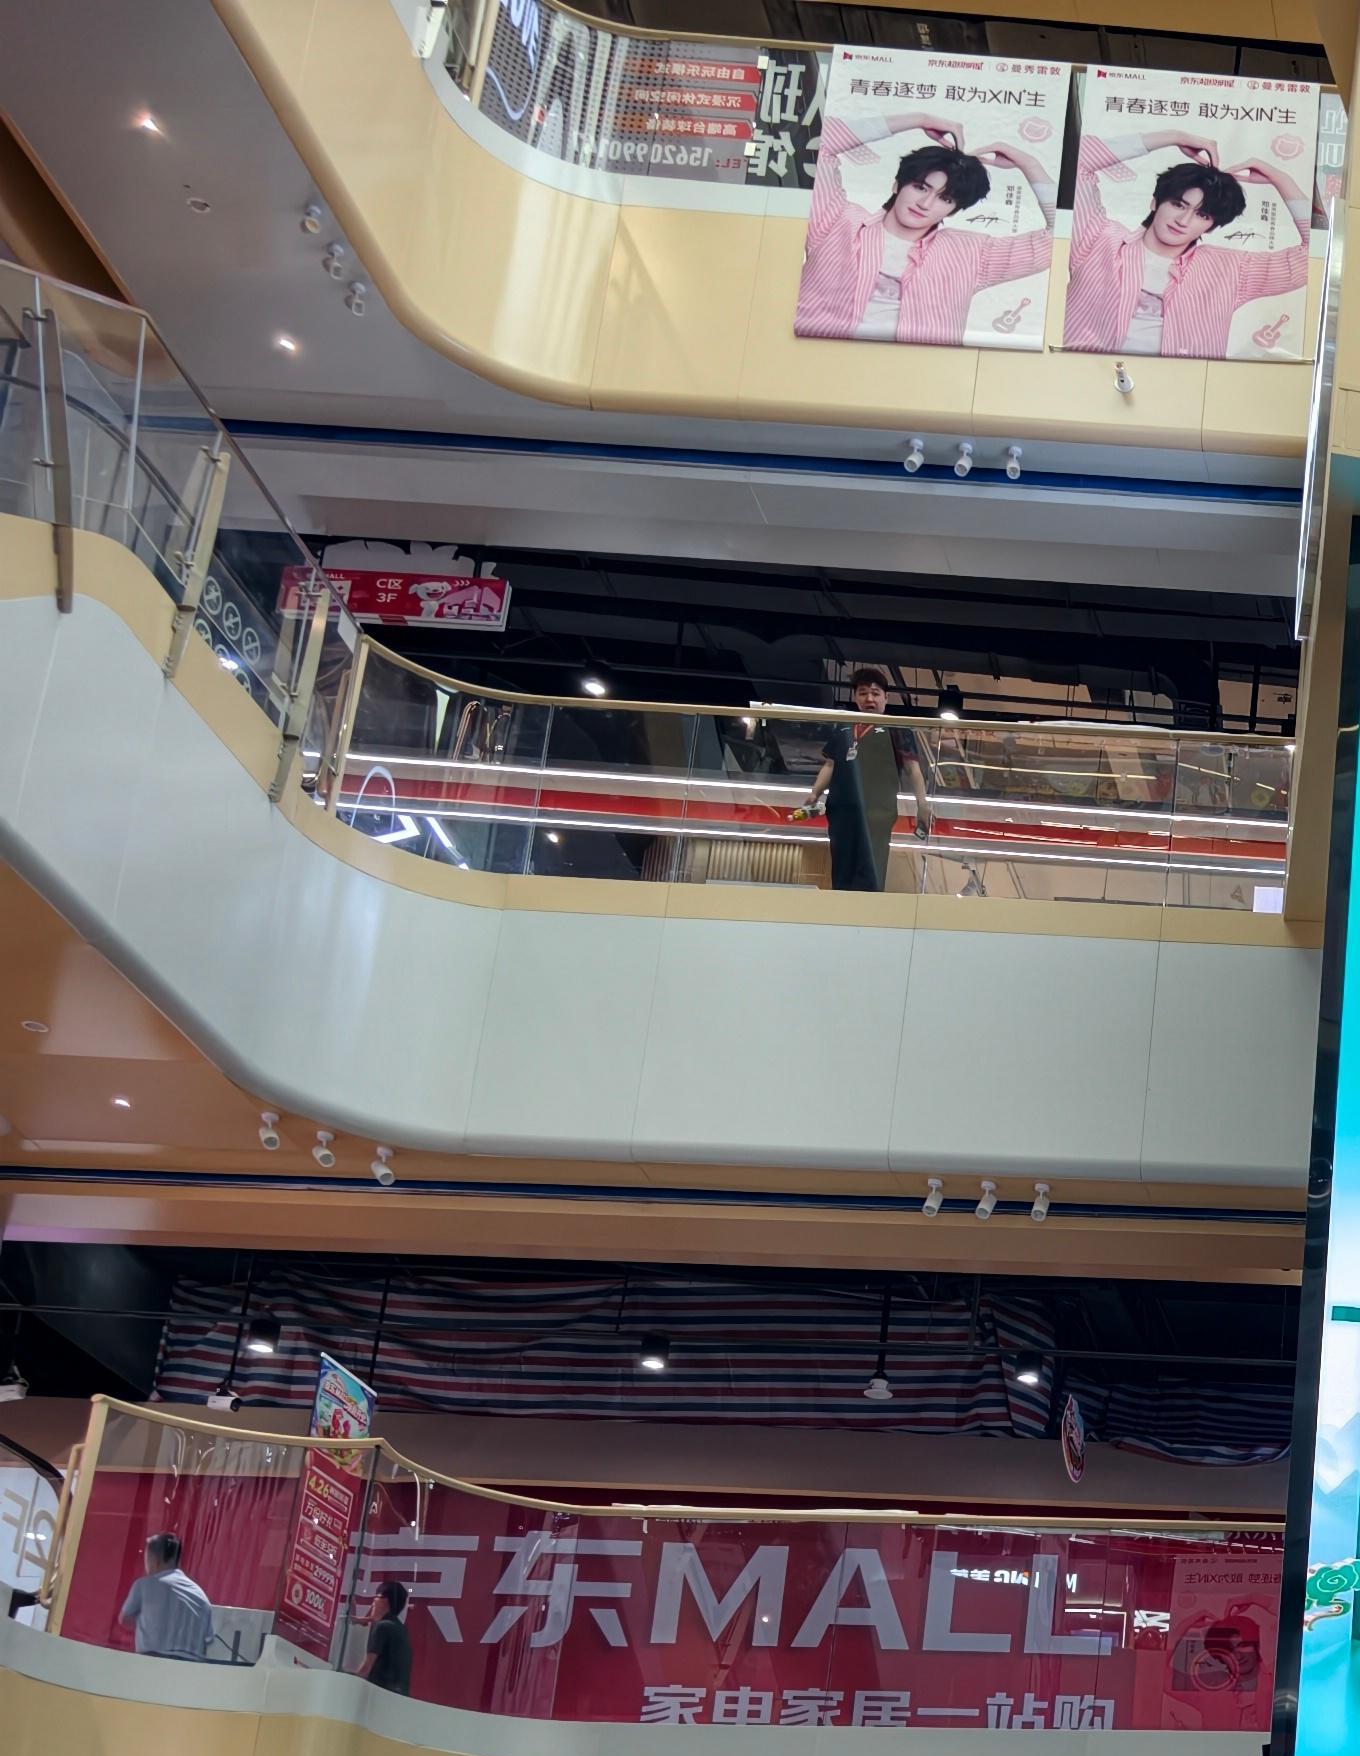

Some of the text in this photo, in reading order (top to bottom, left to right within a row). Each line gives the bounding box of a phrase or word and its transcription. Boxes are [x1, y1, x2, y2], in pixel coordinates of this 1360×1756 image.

[1011, 64, 1062, 76] 曼秀雷敦
[849, 78, 938, 100] 青春逐梦
[1262, 81, 1311, 94] 曼秀雷敦
[1104, 96, 1190, 118] 青春逐梦
[376, 592, 398, 604] 3F
[308, 1477, 330, 1499] 4.26
[343, 1530, 1112, 1656] 京东MALL
